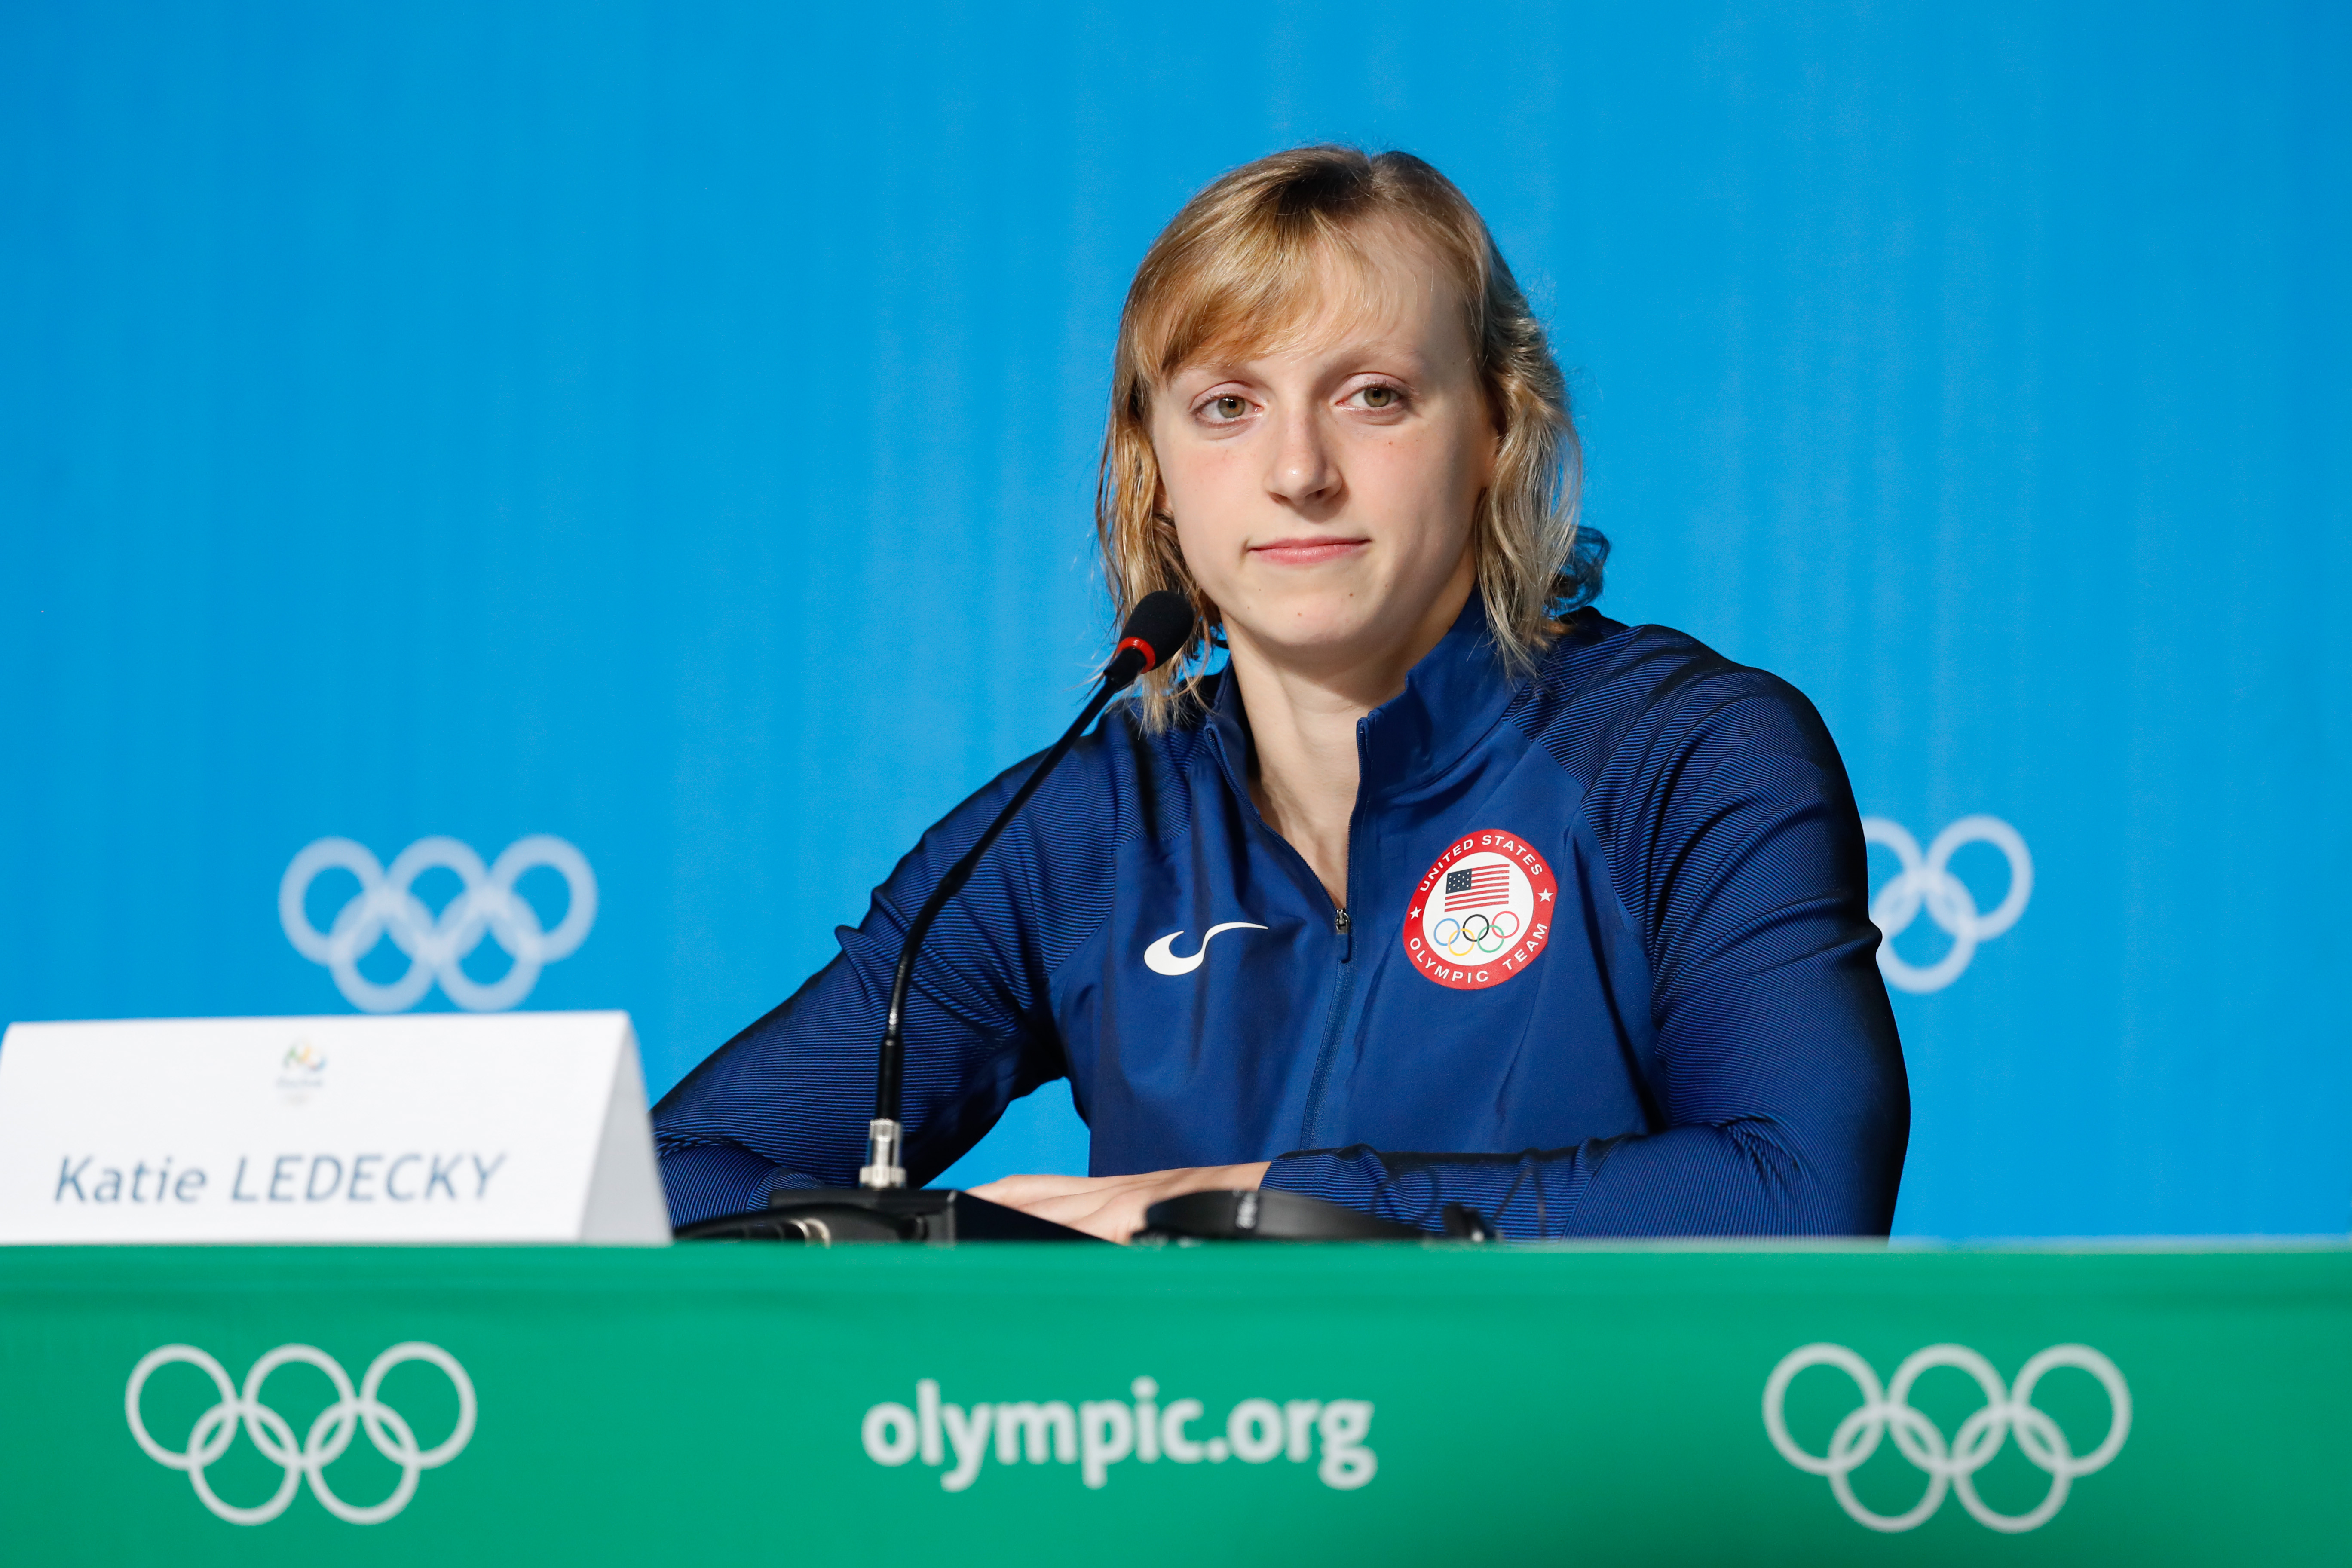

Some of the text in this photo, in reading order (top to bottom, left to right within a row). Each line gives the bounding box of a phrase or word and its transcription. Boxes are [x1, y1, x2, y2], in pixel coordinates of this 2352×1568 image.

[1420, 835, 1543, 892] UNITED STATES
[1410, 923, 1547, 983] OLYMPIC TEAM
[55, 1153, 508, 1203] Katie LEDECKY
[861, 1377, 1377, 1491] olympic.org
